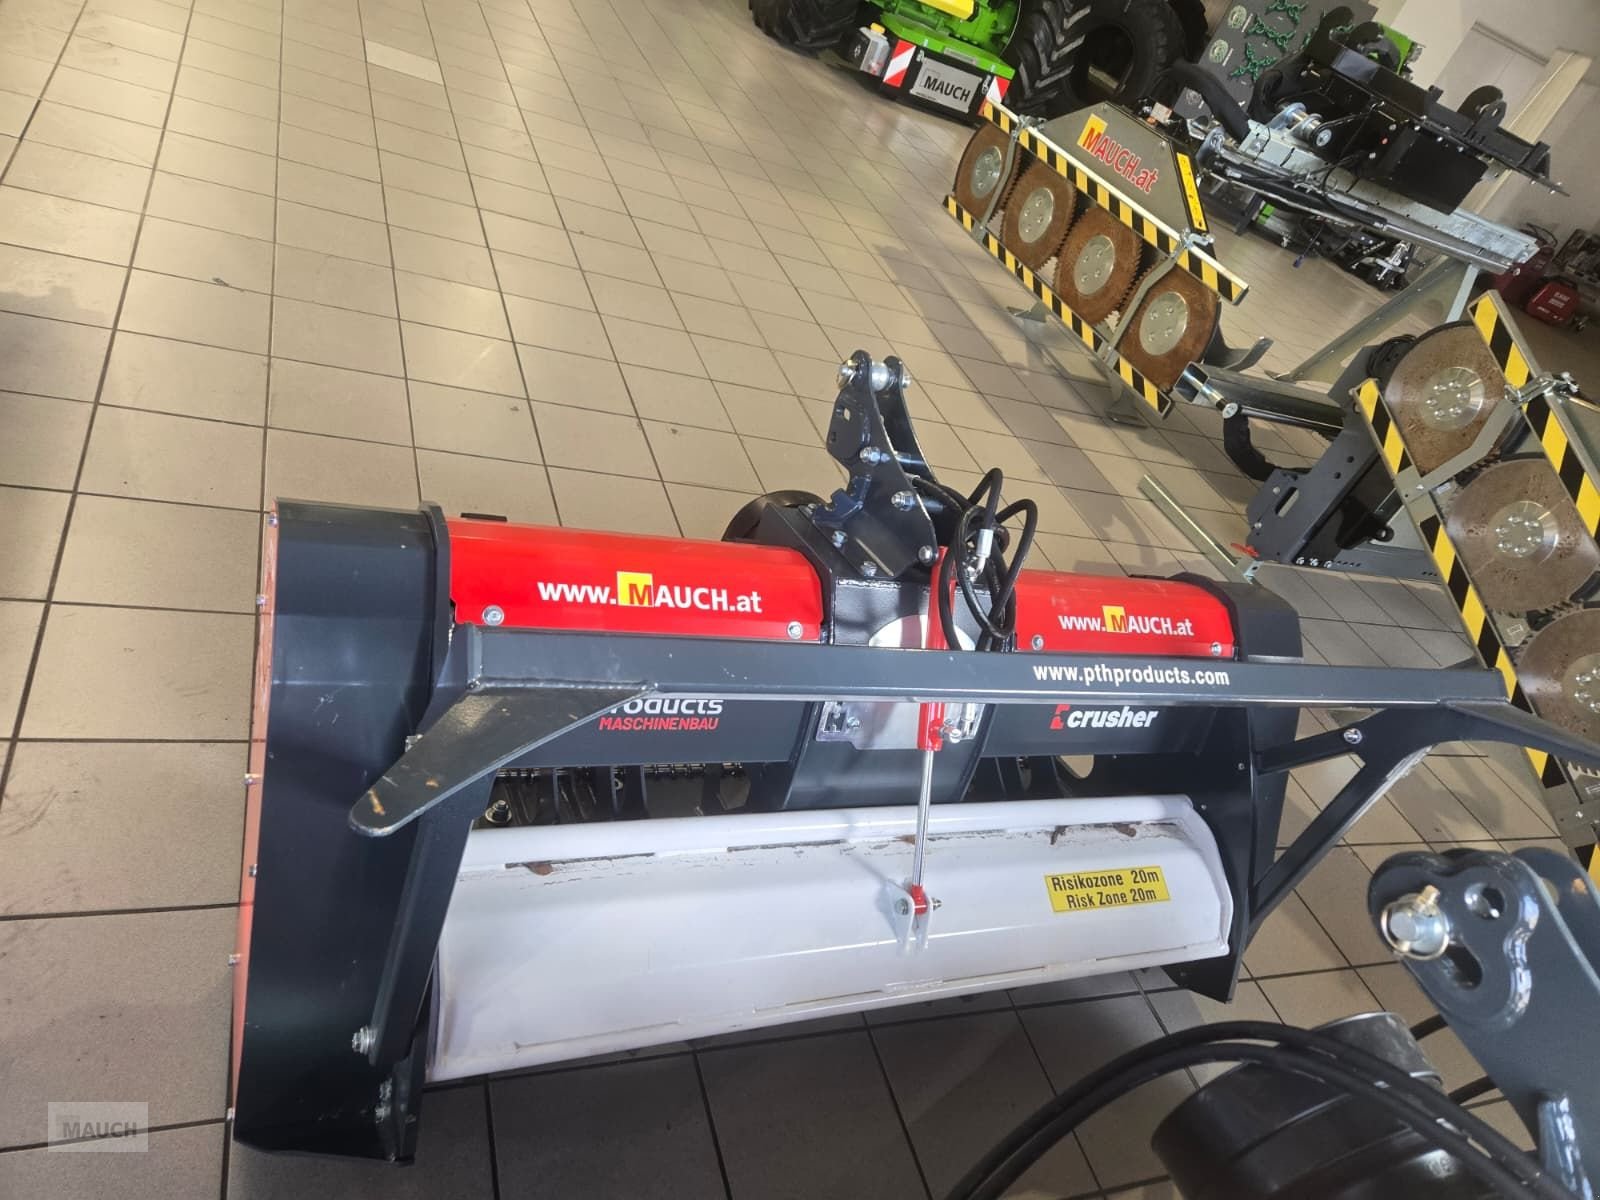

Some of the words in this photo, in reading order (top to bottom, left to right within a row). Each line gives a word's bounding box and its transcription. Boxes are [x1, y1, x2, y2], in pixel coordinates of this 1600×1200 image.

[924, 75, 971, 102] MAUCH
[1081, 126, 1159, 194] MAUCH.at
[537, 582, 762, 612] www.MAUCH.at
[1058, 614, 1193, 635] www.MAUCH.at
[1033, 663, 1230, 687] www.pthproducts.com
[598, 717, 720, 731] MASCHINENBAU
[1066, 705, 1159, 728] crusher
[1051, 873, 1124, 892] Risikozone
[1130, 869, 1160, 884] 20m
[1066, 893, 1096, 909] Risk
[1096, 890, 1128, 906] Zone
[1130, 887, 1157, 902] 20m
